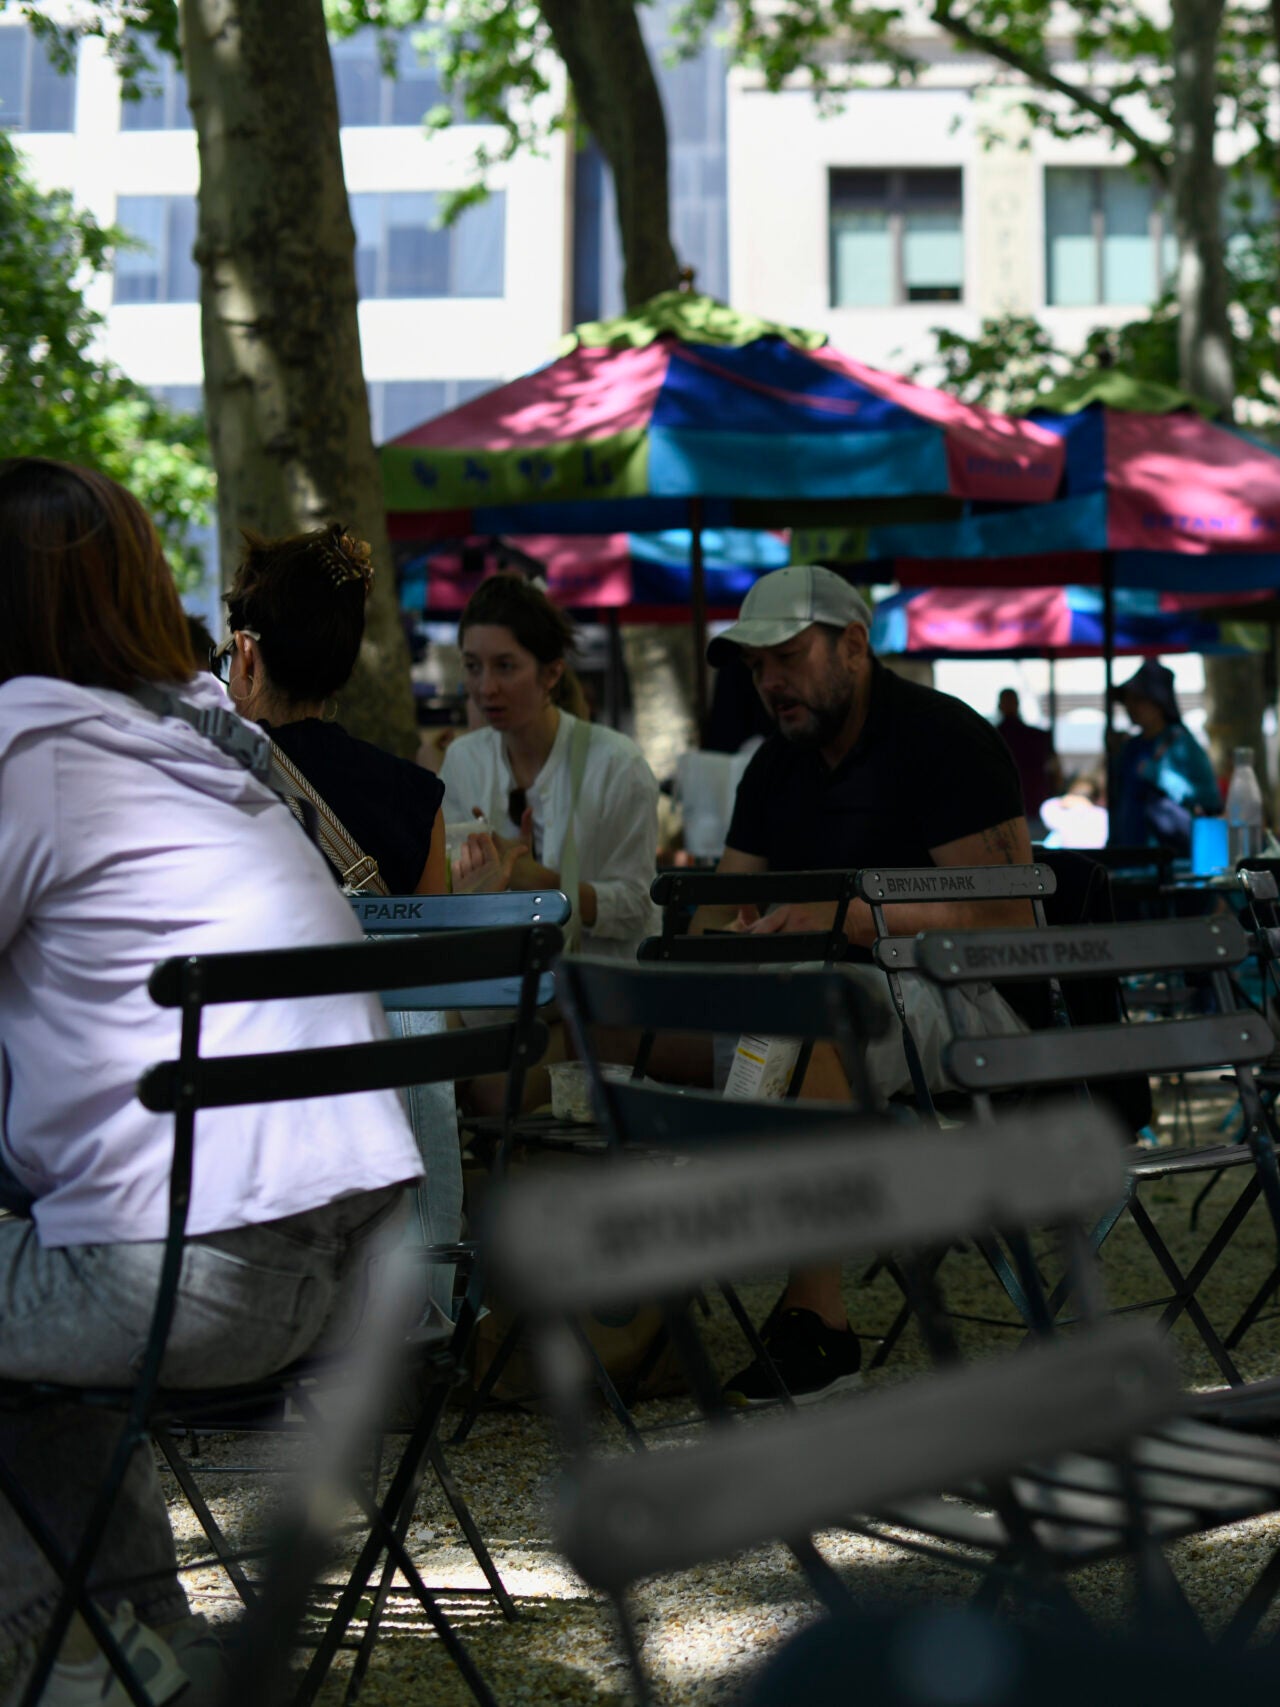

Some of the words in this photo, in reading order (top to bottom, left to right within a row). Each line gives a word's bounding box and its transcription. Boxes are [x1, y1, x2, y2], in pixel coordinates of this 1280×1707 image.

[887, 877, 937, 892] BRYANT
[939, 875, 976, 891] PARK
[364, 903, 424, 920] PARK
[963, 943, 1048, 968] BRYANT
[1053, 939, 1114, 964] PARK
